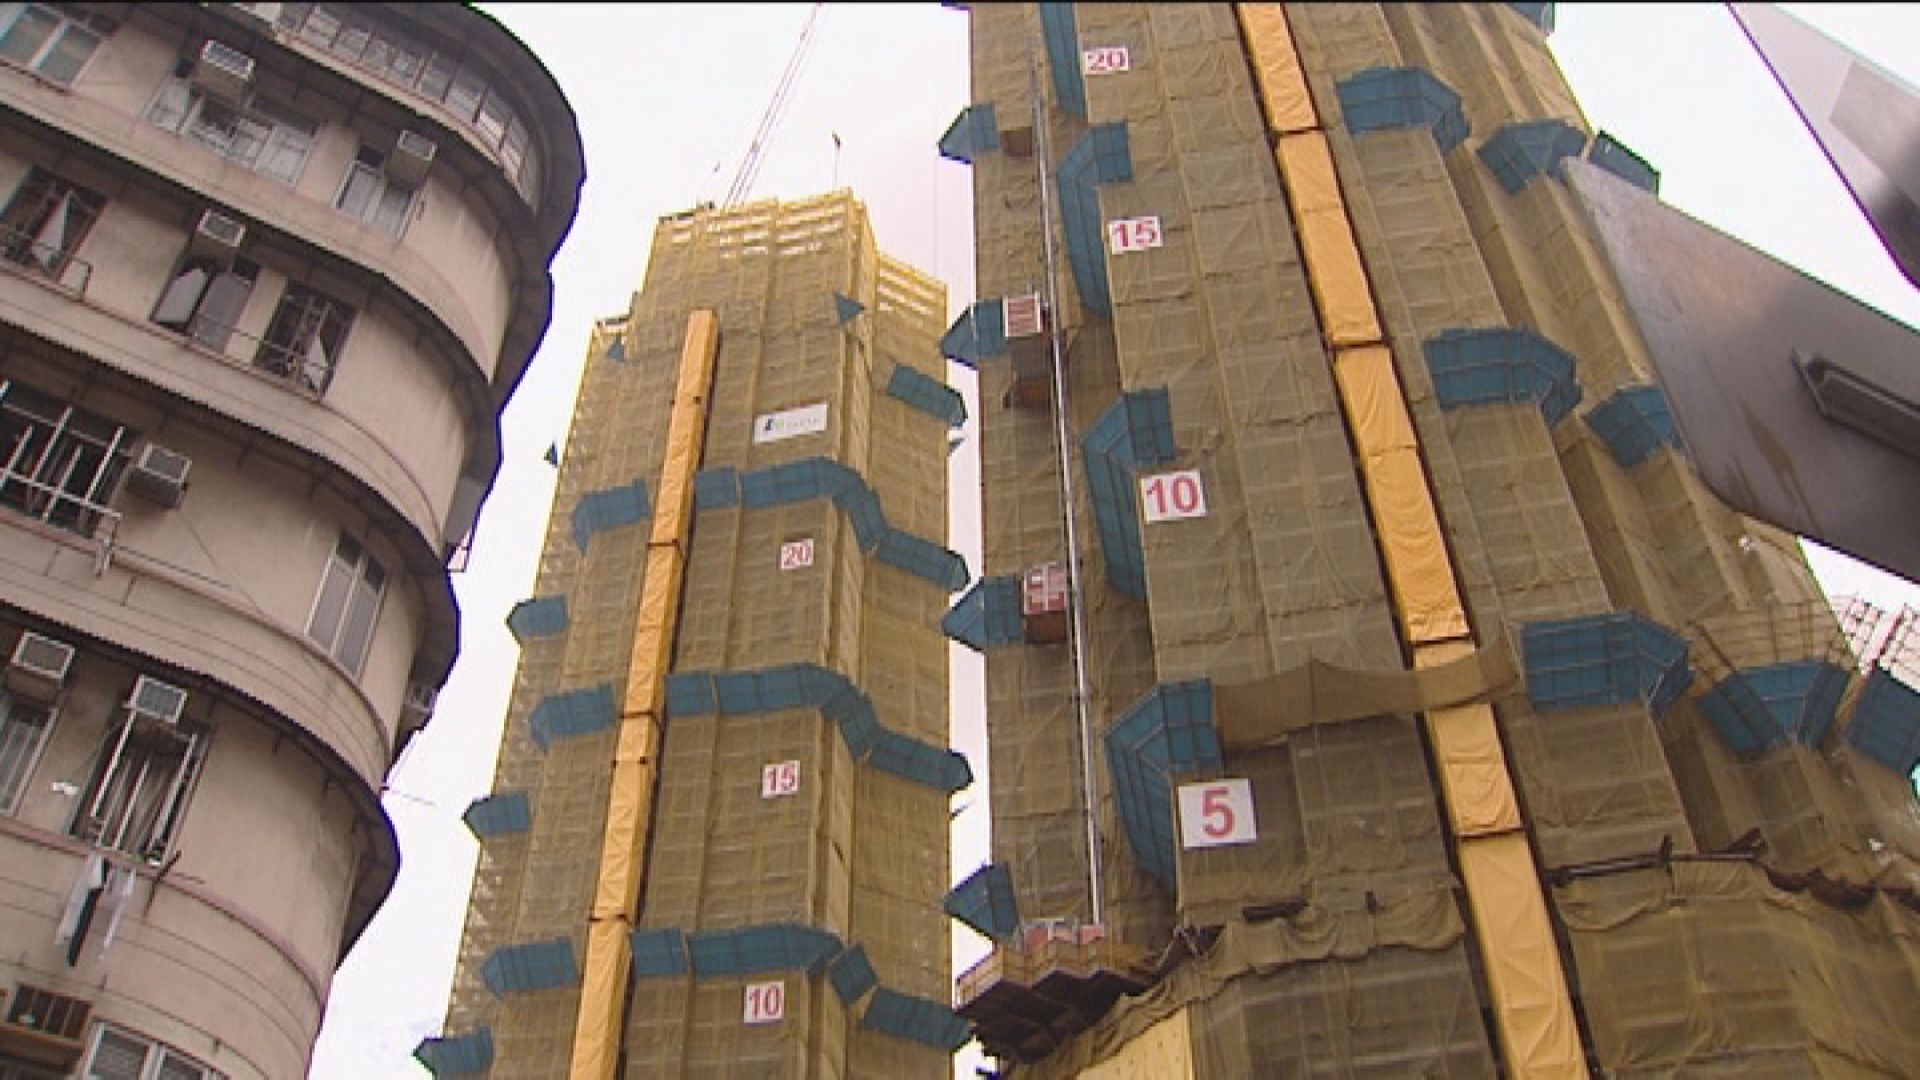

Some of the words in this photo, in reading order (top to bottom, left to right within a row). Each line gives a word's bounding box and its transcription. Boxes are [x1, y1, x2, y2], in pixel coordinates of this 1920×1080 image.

[1087, 51, 1126, 71] 20
[1115, 220, 1157, 247] 15
[1146, 476, 1198, 513] 10
[783, 543, 812, 567] 20
[767, 764, 796, 792] 15
[1202, 786, 1234, 839] 5
[748, 986, 781, 1017] 10
